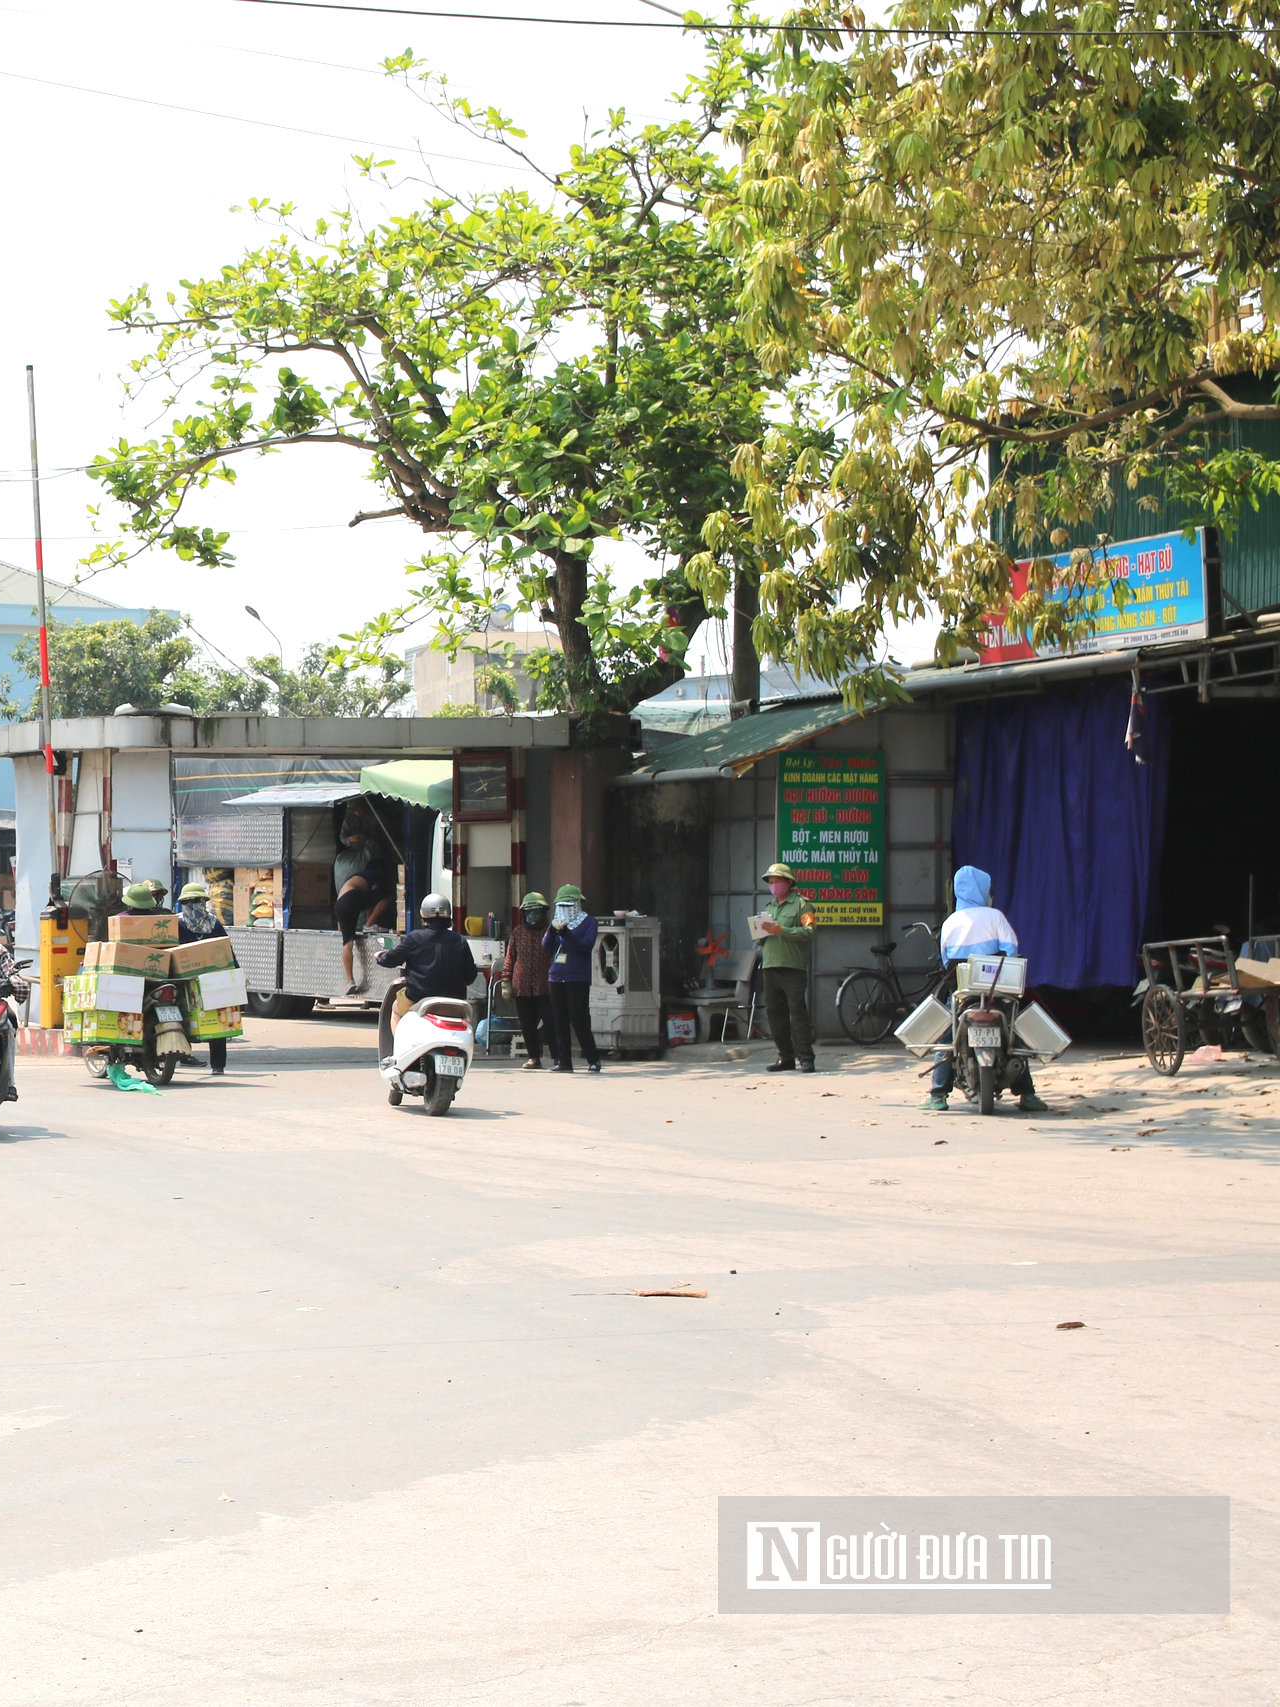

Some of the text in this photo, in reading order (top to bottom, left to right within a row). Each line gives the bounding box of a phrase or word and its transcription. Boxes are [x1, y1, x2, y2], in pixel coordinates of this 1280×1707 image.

[1137, 550, 1157, 579] HẠT
[1117, 609, 1138, 630] NÔNG
[1140, 605, 1155, 627] SẢN
[1162, 603, 1177, 628] BỘT
[783, 770, 878, 785] KINH DOANH CÁC MẶT HÀNG
[784, 786, 878, 805] HẠT HƯỚNG DƯƠNG
[791, 809, 810, 826] HẠT
[792, 828, 810, 846] BỘT
[820, 831, 841, 843] MEN
[844, 829, 869, 846] RƯỢU
[782, 847, 808, 863] NƯỚC
[811, 846, 835, 863] MẮM
[838, 847, 861, 863] THỦY
[793, 867, 831, 882] TƯƠNG
[819, 885, 852, 901] NÔNG
[854, 885, 878, 901] SẢN
[826, 905, 838, 914] BẾN
[840, 906, 848, 914] XE
[849, 906, 861, 915] CHỢ
[863, 906, 878, 914] VINH
